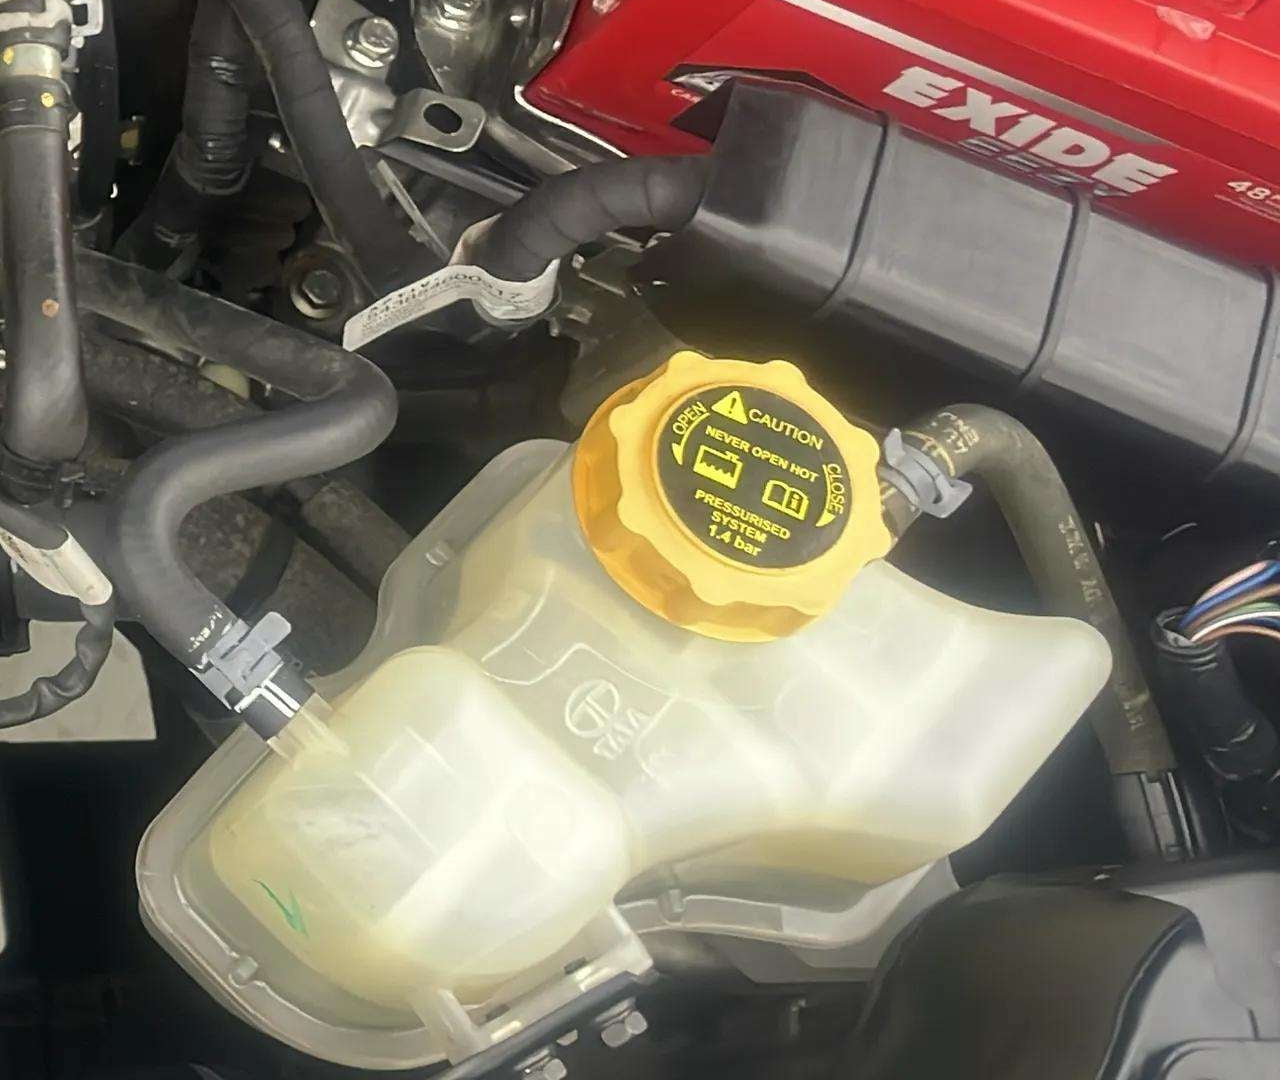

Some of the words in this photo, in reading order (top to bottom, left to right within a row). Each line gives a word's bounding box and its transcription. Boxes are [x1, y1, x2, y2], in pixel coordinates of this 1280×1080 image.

[881, 66, 1179, 194] EXIDE
[671, 401, 708, 436] OPEN
[748, 408, 824, 451] CAUTION
[704, 425, 751, 452] NEVER
[751, 446, 789, 470] OPEN
[789, 463, 820, 483] HOT
[826, 463, 845, 514] CLOSE
[694, 489, 792, 541] PRESSURISED
[710, 510, 768, 544] SYSTEM
[708, 524, 730, 544] 1.4
[734, 534, 763, 557] bar
